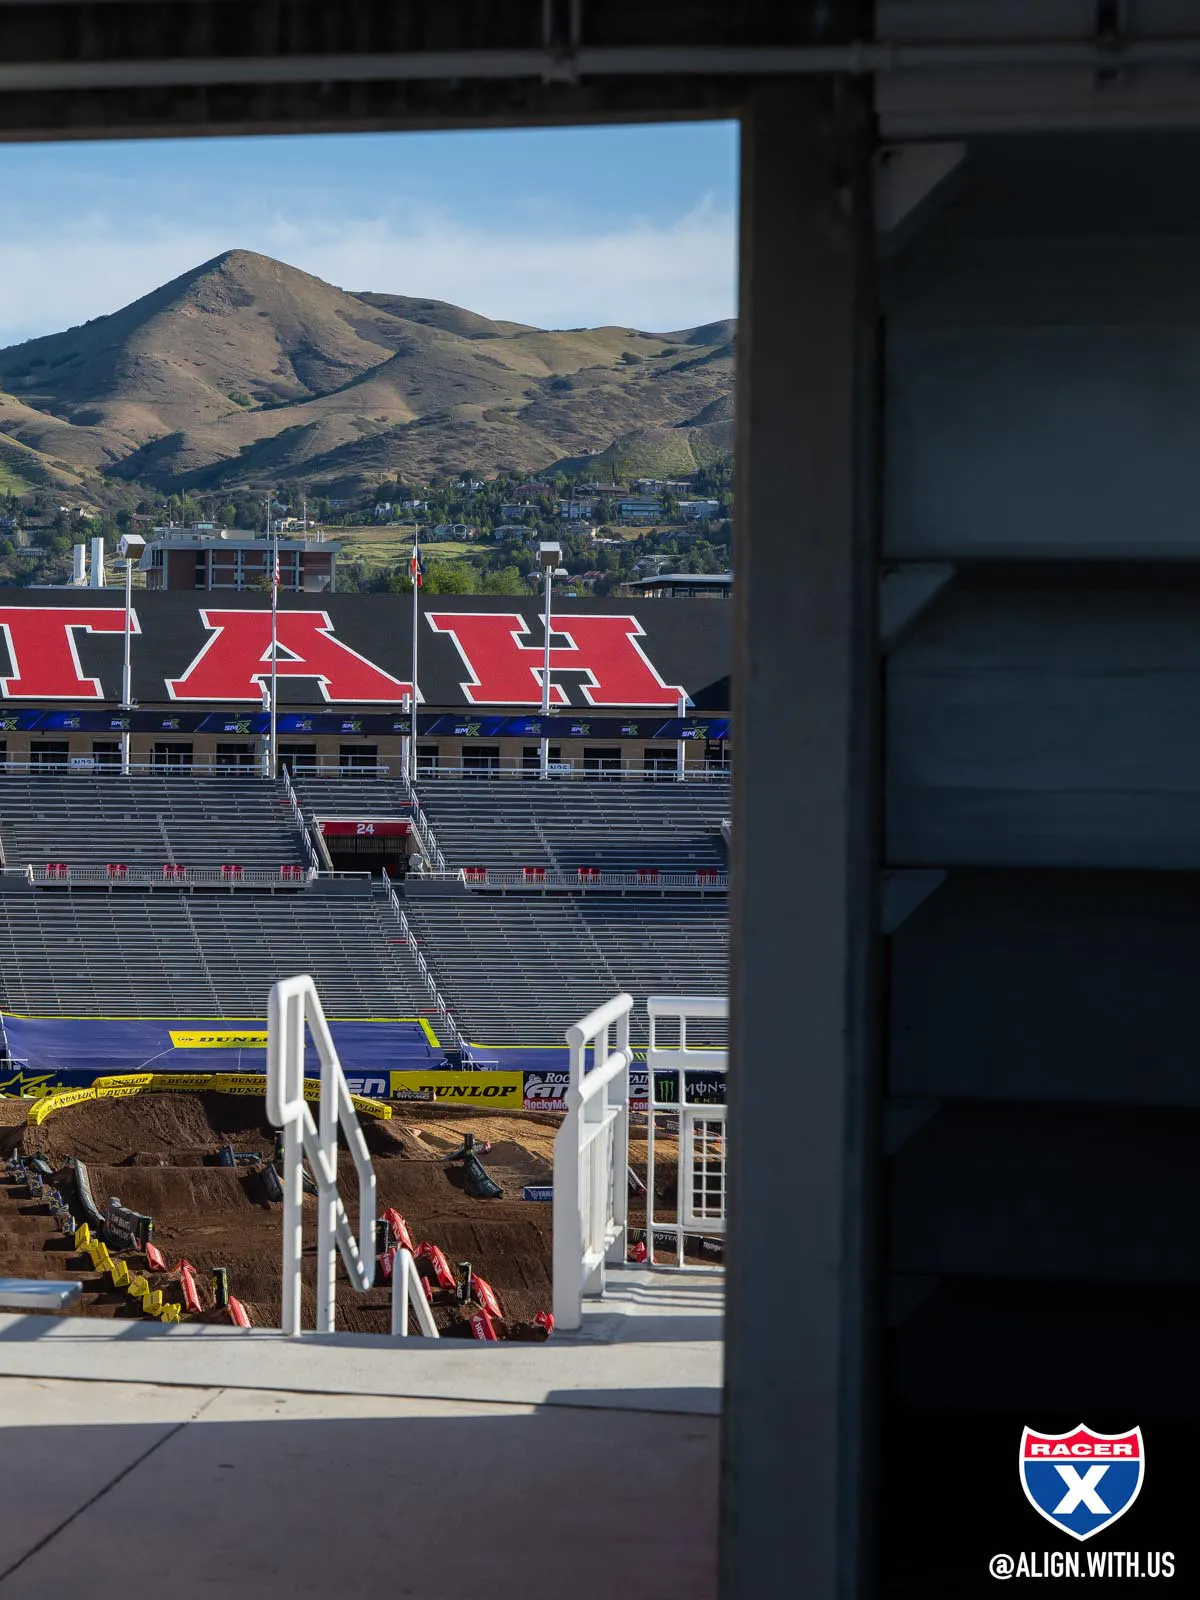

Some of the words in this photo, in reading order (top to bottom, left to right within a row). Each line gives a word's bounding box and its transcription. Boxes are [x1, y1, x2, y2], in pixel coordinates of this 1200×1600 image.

[224, 722, 250, 734] SMX
[454, 725, 480, 737] SMX
[681, 728, 708, 739] SMX
[356, 823, 376, 835] 24
